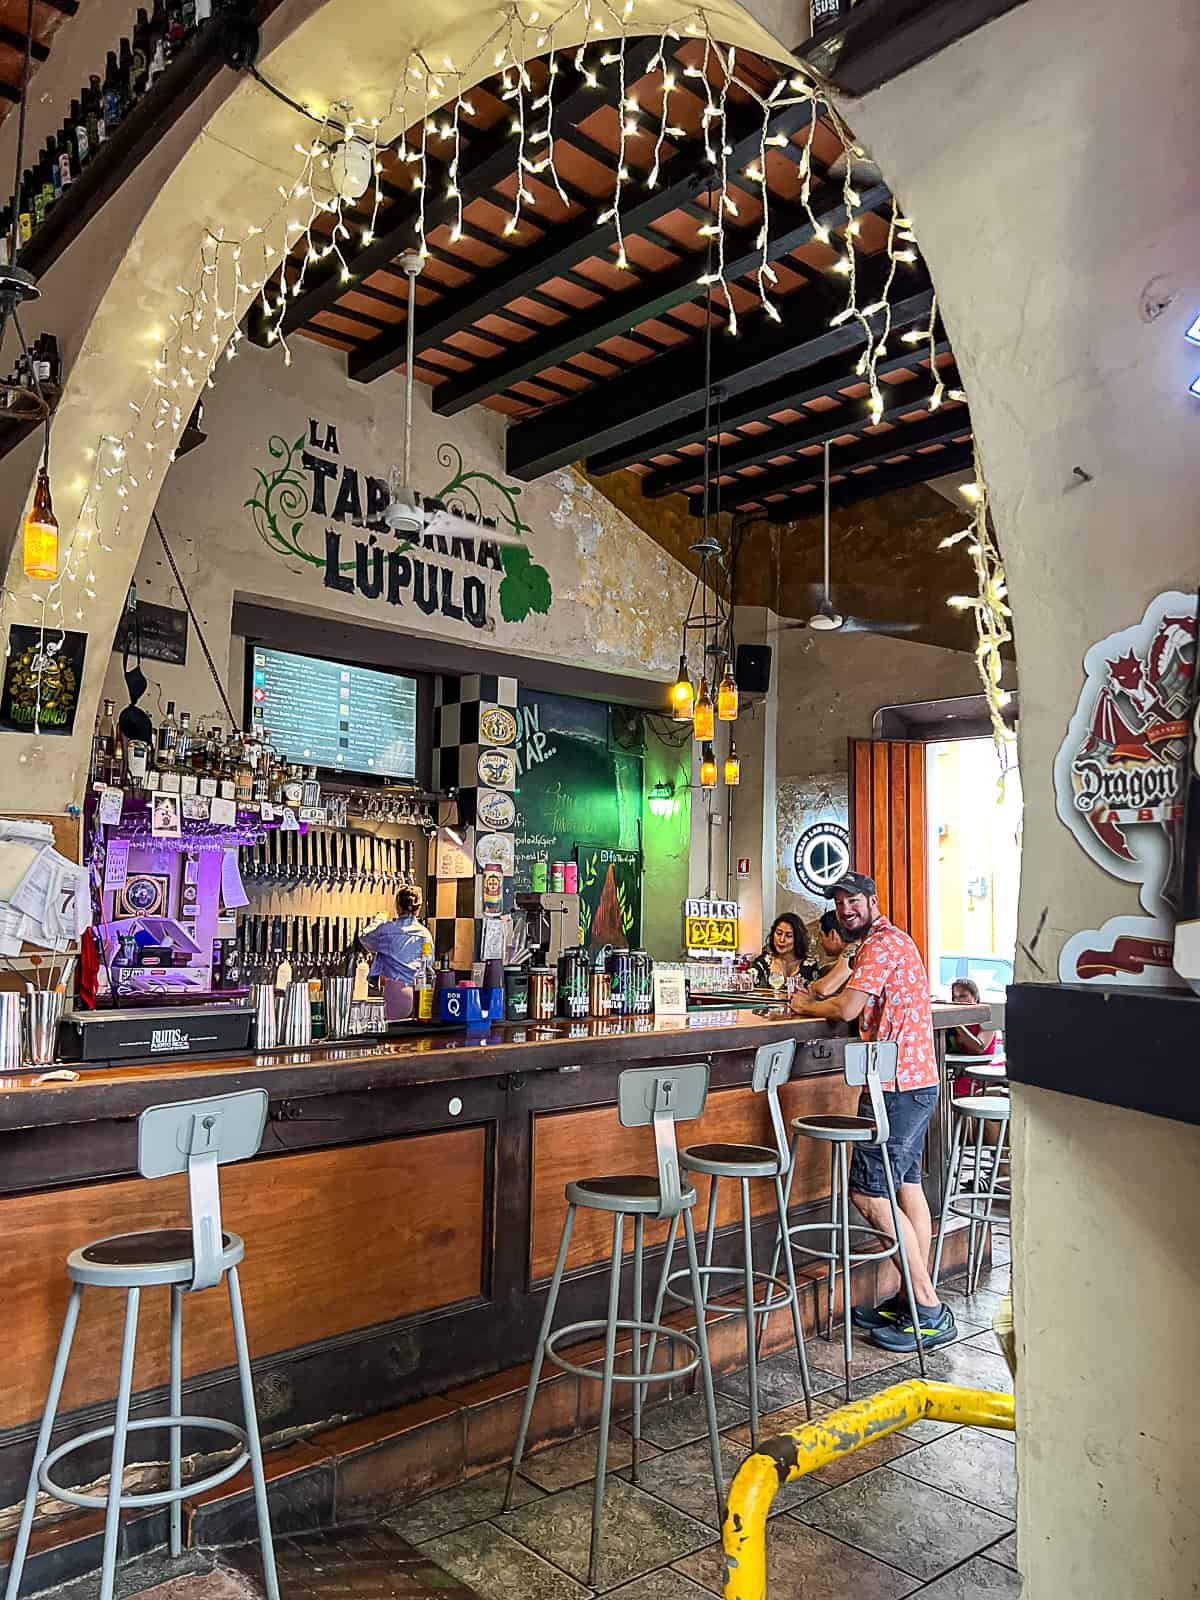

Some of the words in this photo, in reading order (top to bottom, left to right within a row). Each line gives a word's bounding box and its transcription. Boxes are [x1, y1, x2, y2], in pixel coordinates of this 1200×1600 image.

[307, 417, 339, 454] LA
[1072, 760, 1177, 811] Dragon
[61, 888, 76, 914] 7
[447, 998, 461, 1017] Q
[152, 1028, 181, 1044] RUMS
